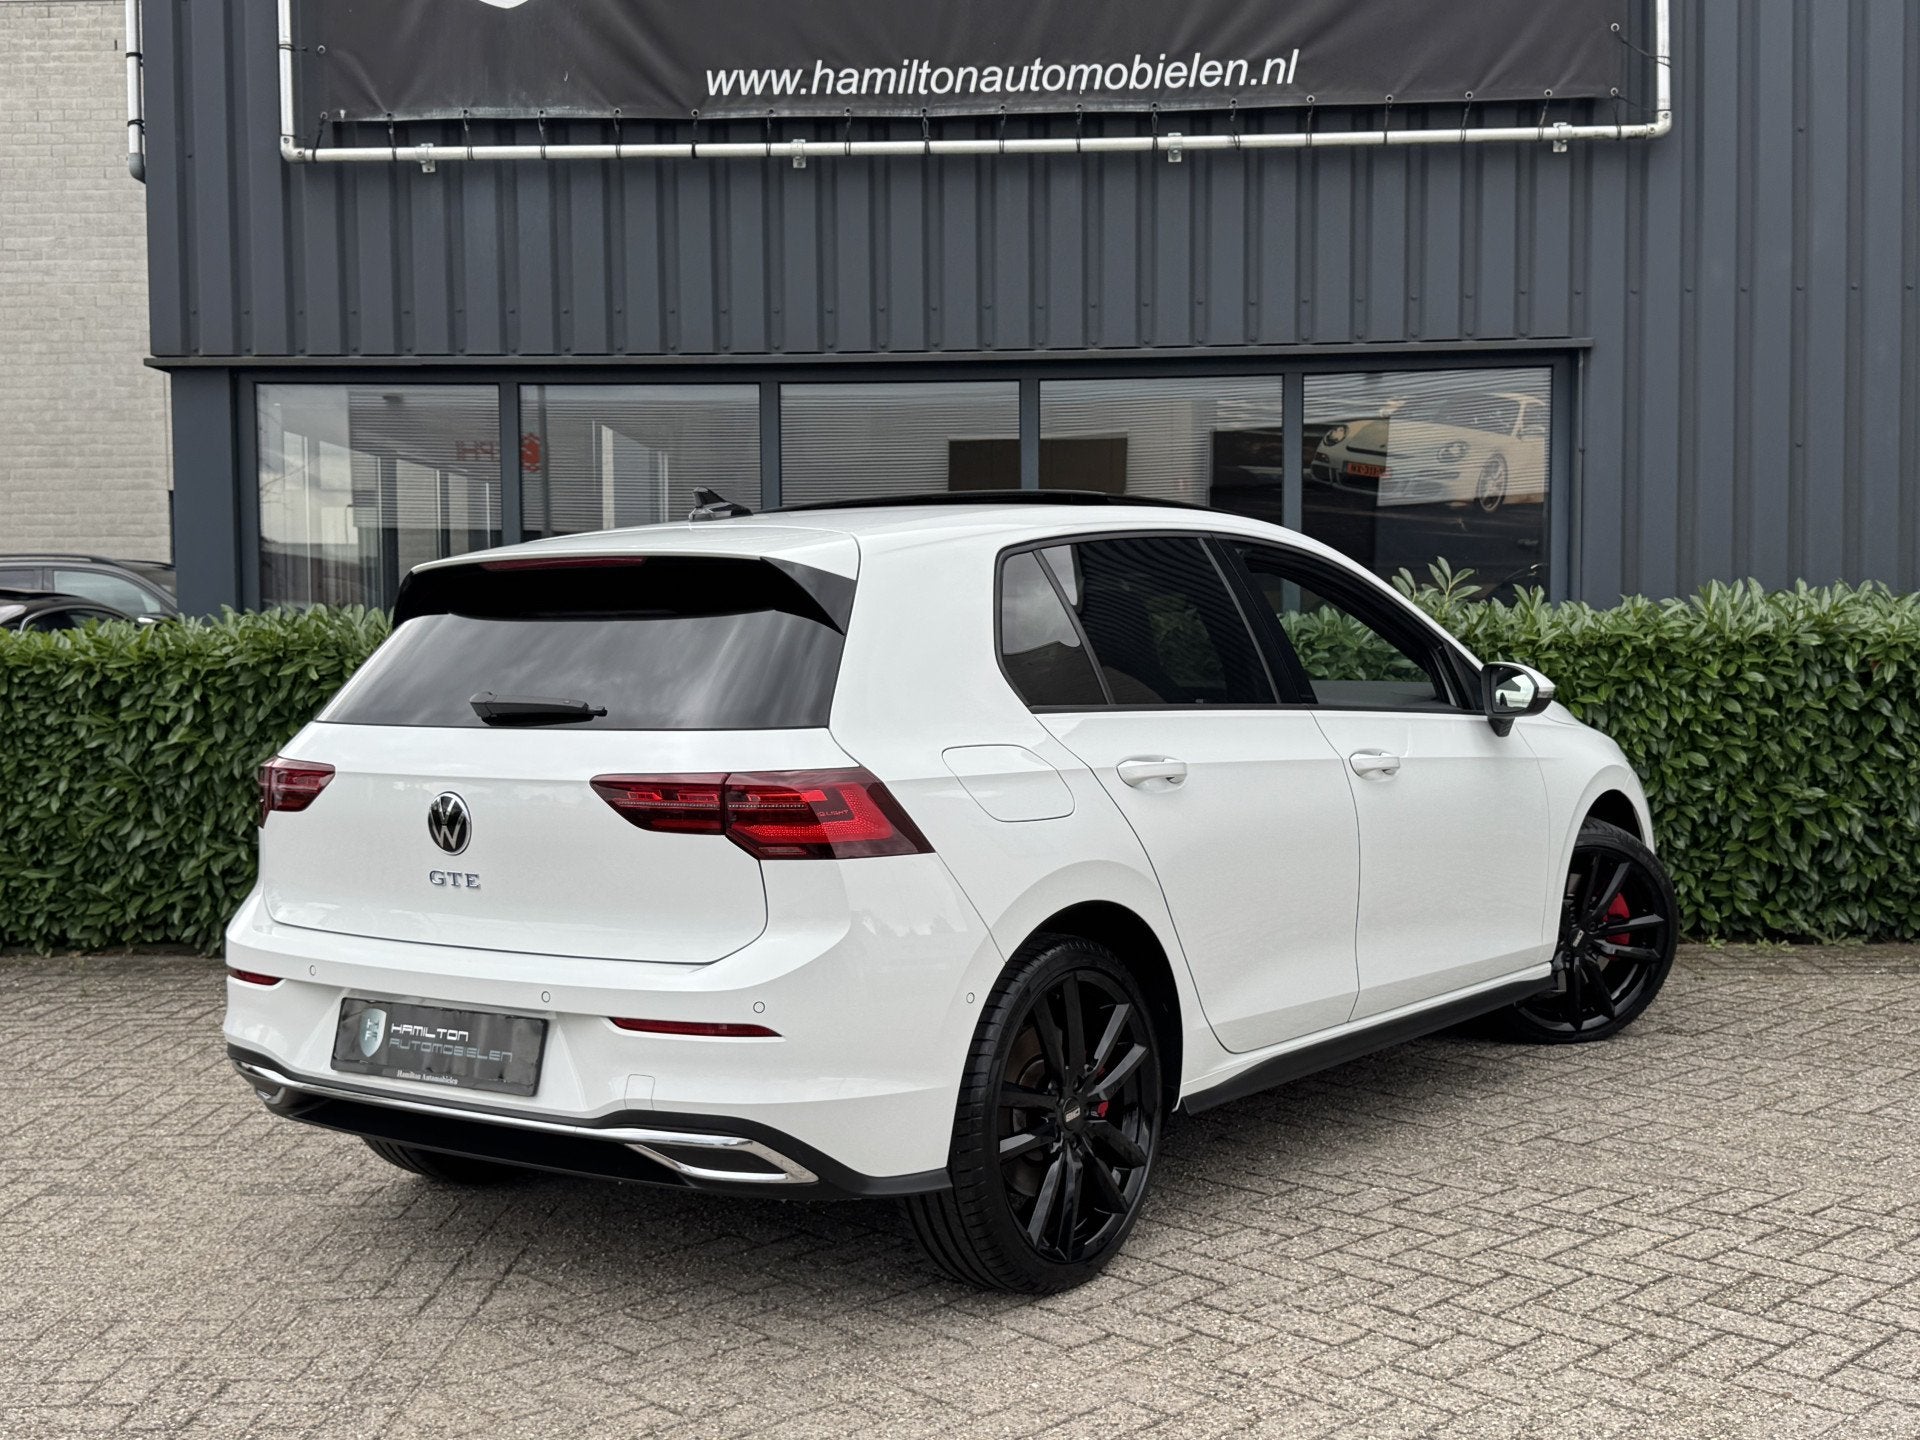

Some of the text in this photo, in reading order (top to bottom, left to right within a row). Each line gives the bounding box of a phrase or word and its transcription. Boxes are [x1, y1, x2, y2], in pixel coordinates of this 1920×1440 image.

[706, 49, 1300, 96] www.hamiltonautomobielen.nl
[429, 869, 481, 889] GTE
[391, 1023, 469, 1042] HAMILTON
